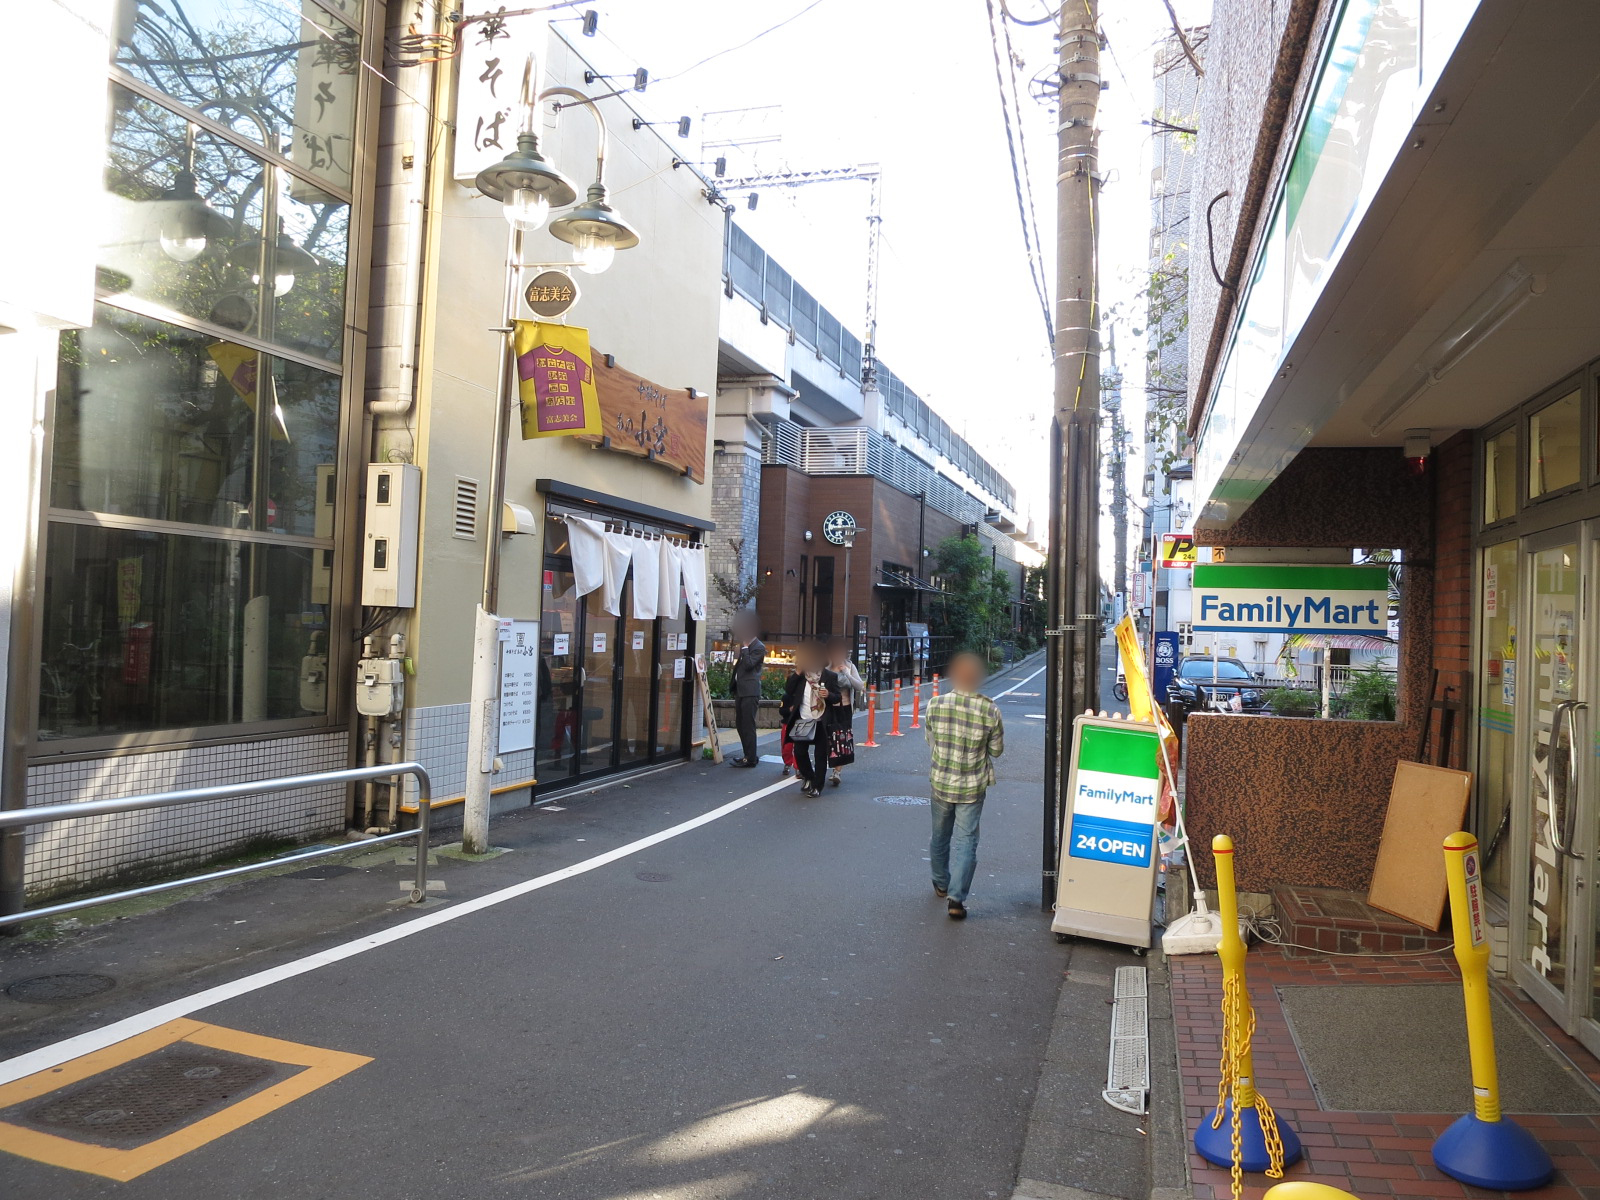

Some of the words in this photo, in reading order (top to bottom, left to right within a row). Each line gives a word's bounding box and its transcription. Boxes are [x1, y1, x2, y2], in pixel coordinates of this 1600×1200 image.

[530, 286, 572, 302] 富志美会
[1200, 595, 1380, 627] FamilyMart
[1079, 785, 1153, 805] FamilyMart
[1076, 834, 1097, 850] 24
[1098, 838, 1146, 858] OPEN
